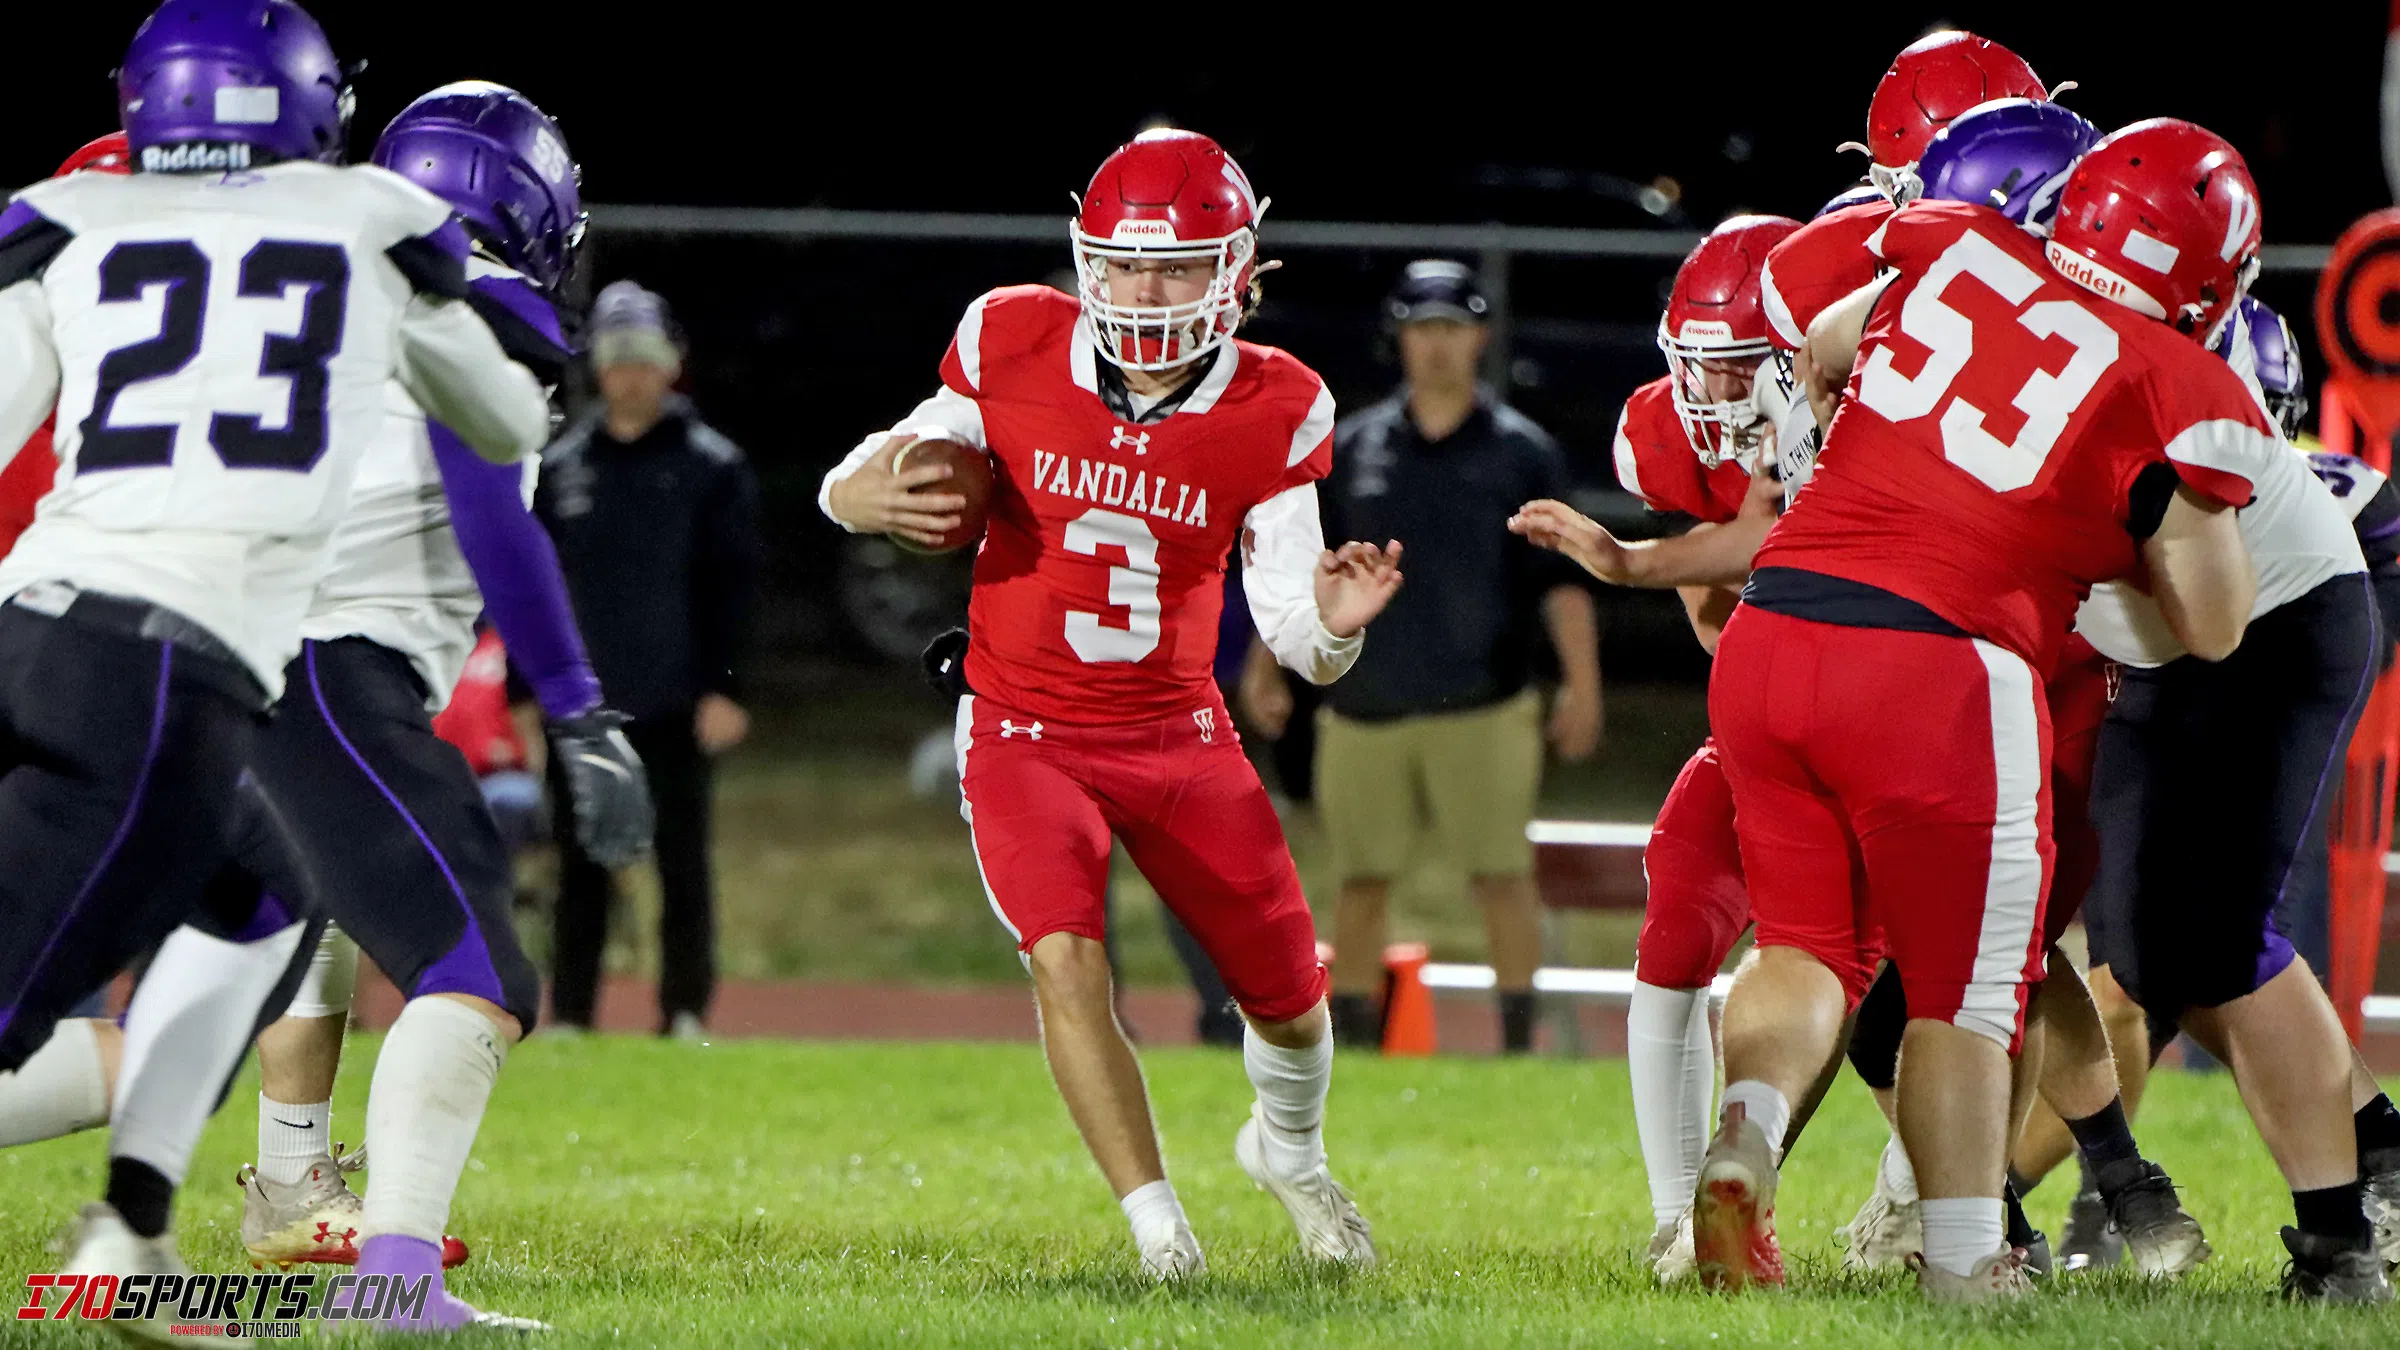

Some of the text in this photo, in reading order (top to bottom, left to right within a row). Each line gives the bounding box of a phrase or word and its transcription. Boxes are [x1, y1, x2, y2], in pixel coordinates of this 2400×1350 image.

[141, 142, 251, 171] Riddell
[1120, 224, 1167, 235] Riddell
[2050, 247, 2127, 297] Riddell
[76, 238, 351, 474] 23
[1858, 227, 2120, 494] 53
[1034, 448, 1208, 529] VANDALIA
[1063, 507, 1162, 664] 3
